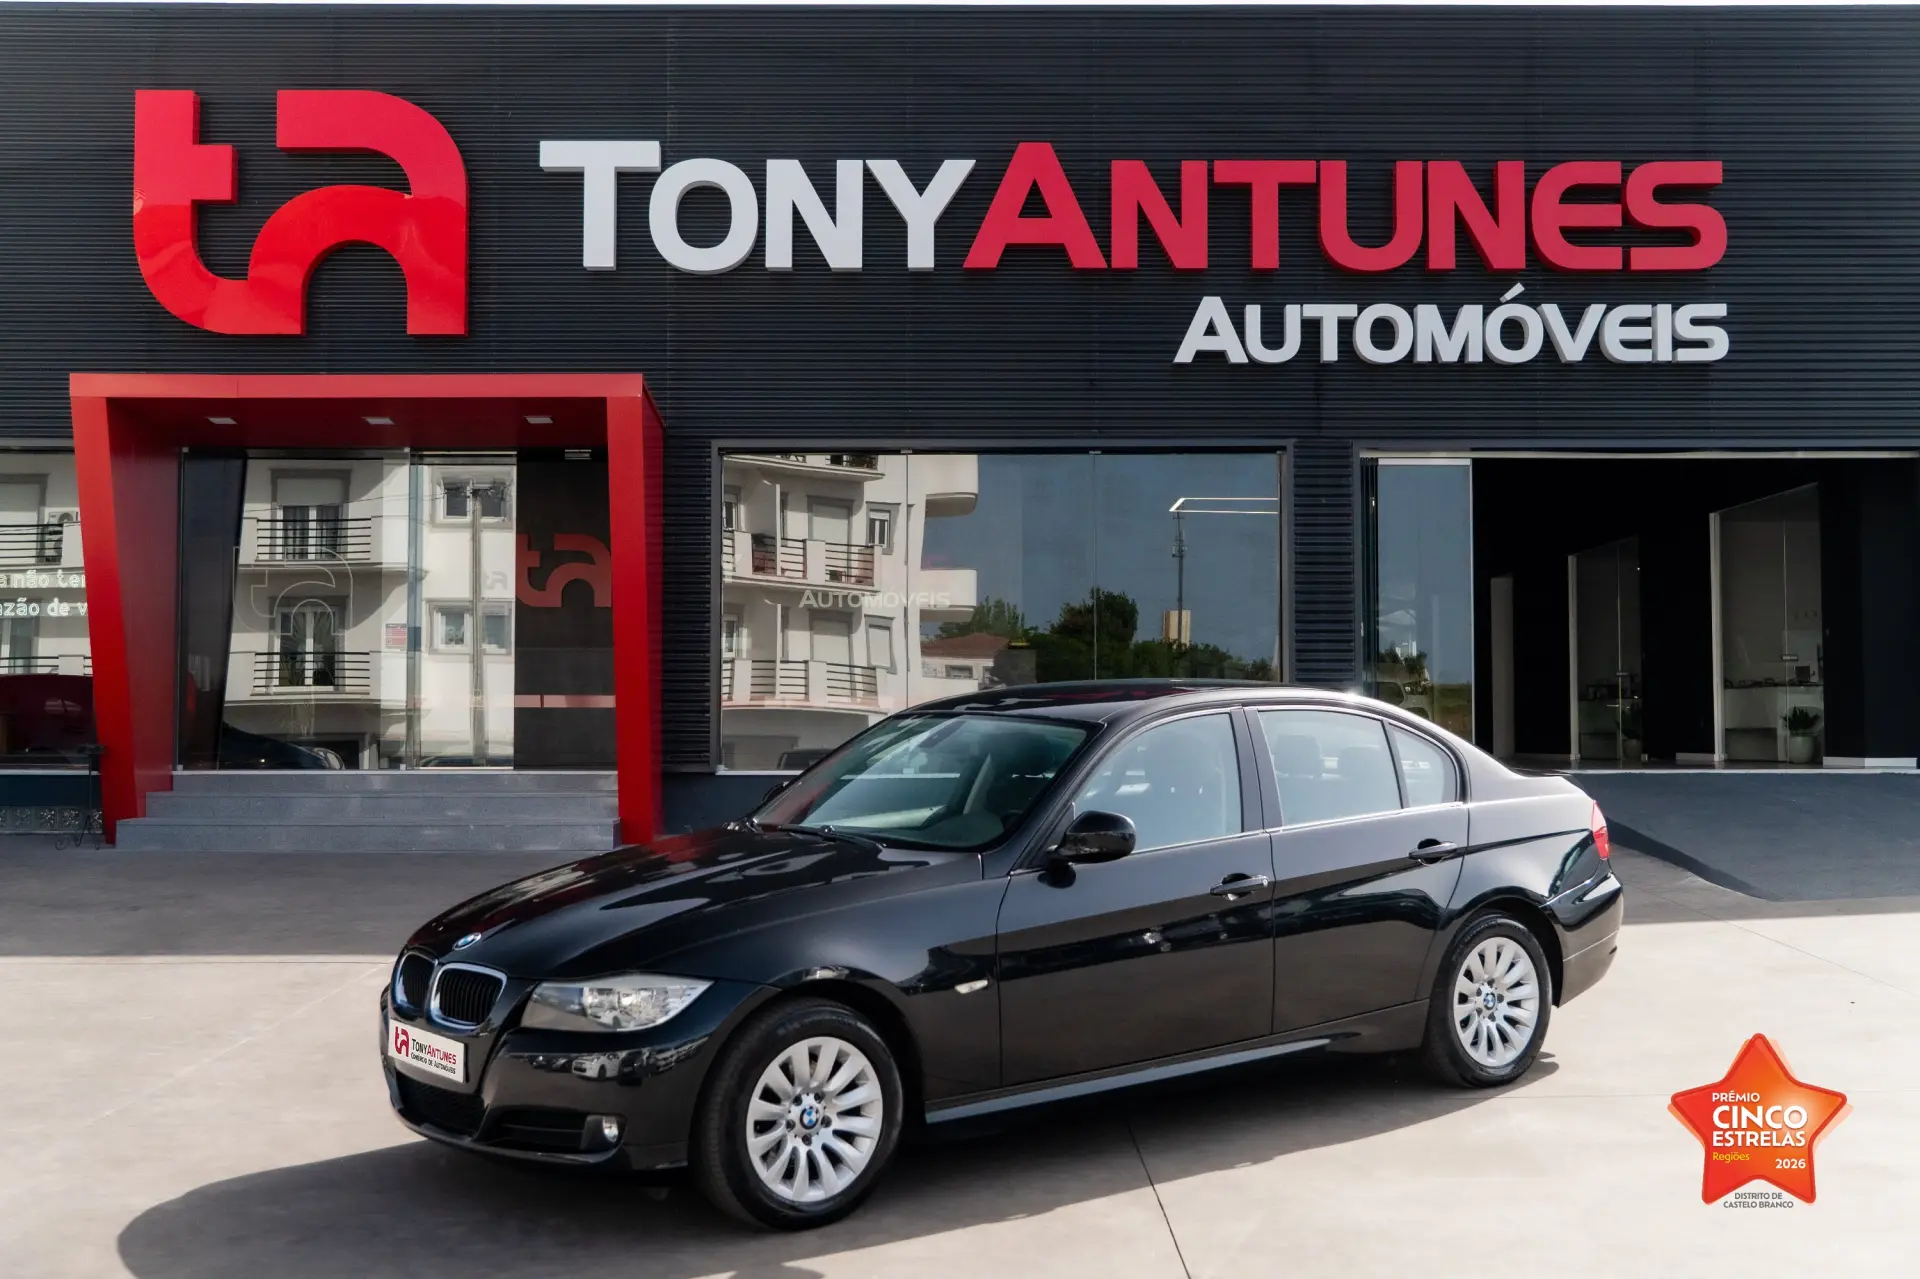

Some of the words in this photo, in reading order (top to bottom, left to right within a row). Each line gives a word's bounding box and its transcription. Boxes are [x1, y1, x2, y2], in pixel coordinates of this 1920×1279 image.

[1173, 283, 1730, 365] AUTOMÓVEIS
[13, 569, 50, 588] não
[0, 597, 40, 616] zão
[47, 597, 70, 616] de
[799, 588, 951, 608] AUTOMÓVEIS
